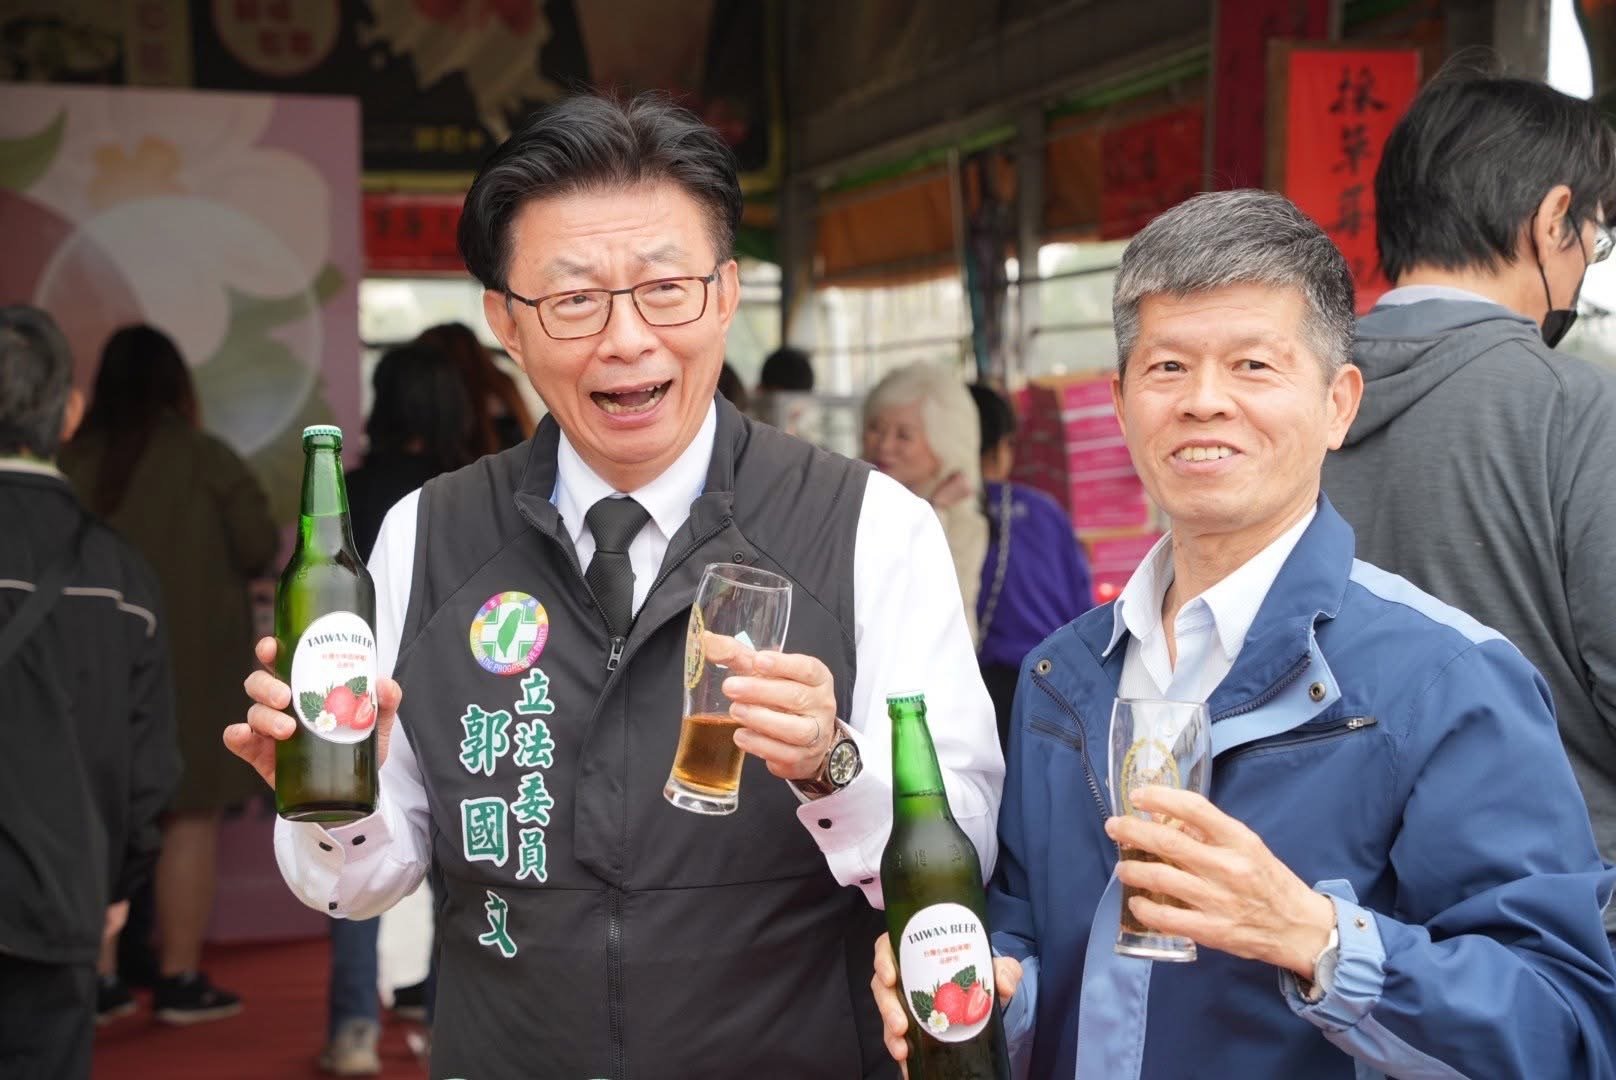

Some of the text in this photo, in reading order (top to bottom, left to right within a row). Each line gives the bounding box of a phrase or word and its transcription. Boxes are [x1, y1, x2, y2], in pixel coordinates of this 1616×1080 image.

[306, 633, 372, 649] TAIWAN BEER
[460, 705, 516, 957] 郭國文
[511, 668, 554, 882] 立法委員
[908, 923, 977, 944] TAIWAN BEER
